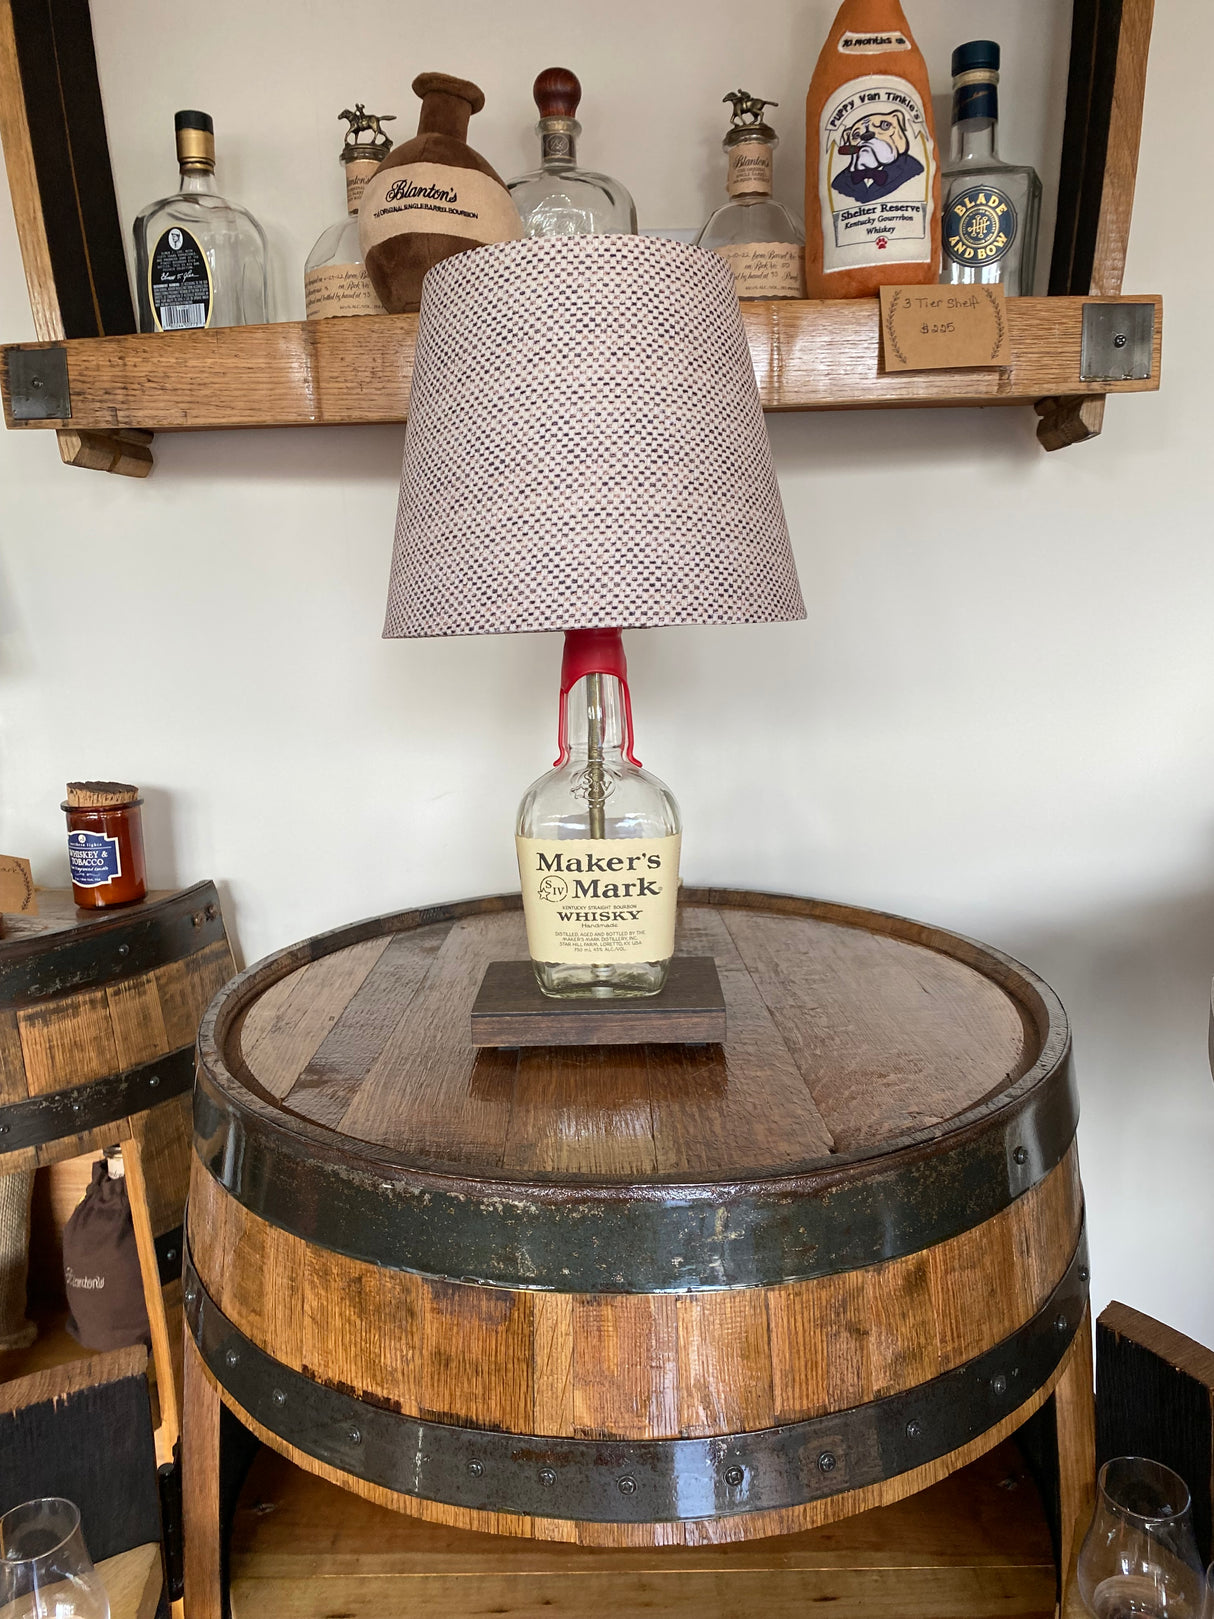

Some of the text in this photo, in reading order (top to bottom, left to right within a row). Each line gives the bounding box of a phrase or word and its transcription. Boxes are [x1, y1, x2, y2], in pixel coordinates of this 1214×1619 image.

[859, 92, 880, 103] Van
[885, 92, 921, 120] Tinkle's
[385, 179, 458, 203] Blanton's
[403, 203, 425, 211] SINGLE
[424, 203, 449, 213] BARREL
[448, 207, 479, 220] BOURBON
[840, 204, 921, 222] Shelter Reserve
[954, 193, 1008, 216] BLADE
[844, 217, 876, 230] Kentucky
[866, 227, 896, 235] Whiskey
[949, 232, 1008, 260] AND BOW
[903, 295, 980, 310] 3 Tier Shelf
[920, 322, 956, 335] $225
[71, 858, 104, 866] TOBACCO
[101, 850, 108, 858] &
[536, 852, 661, 873] Maker's
[572, 877, 661, 899] Mark
[557, 910, 643, 922] WHISKY
